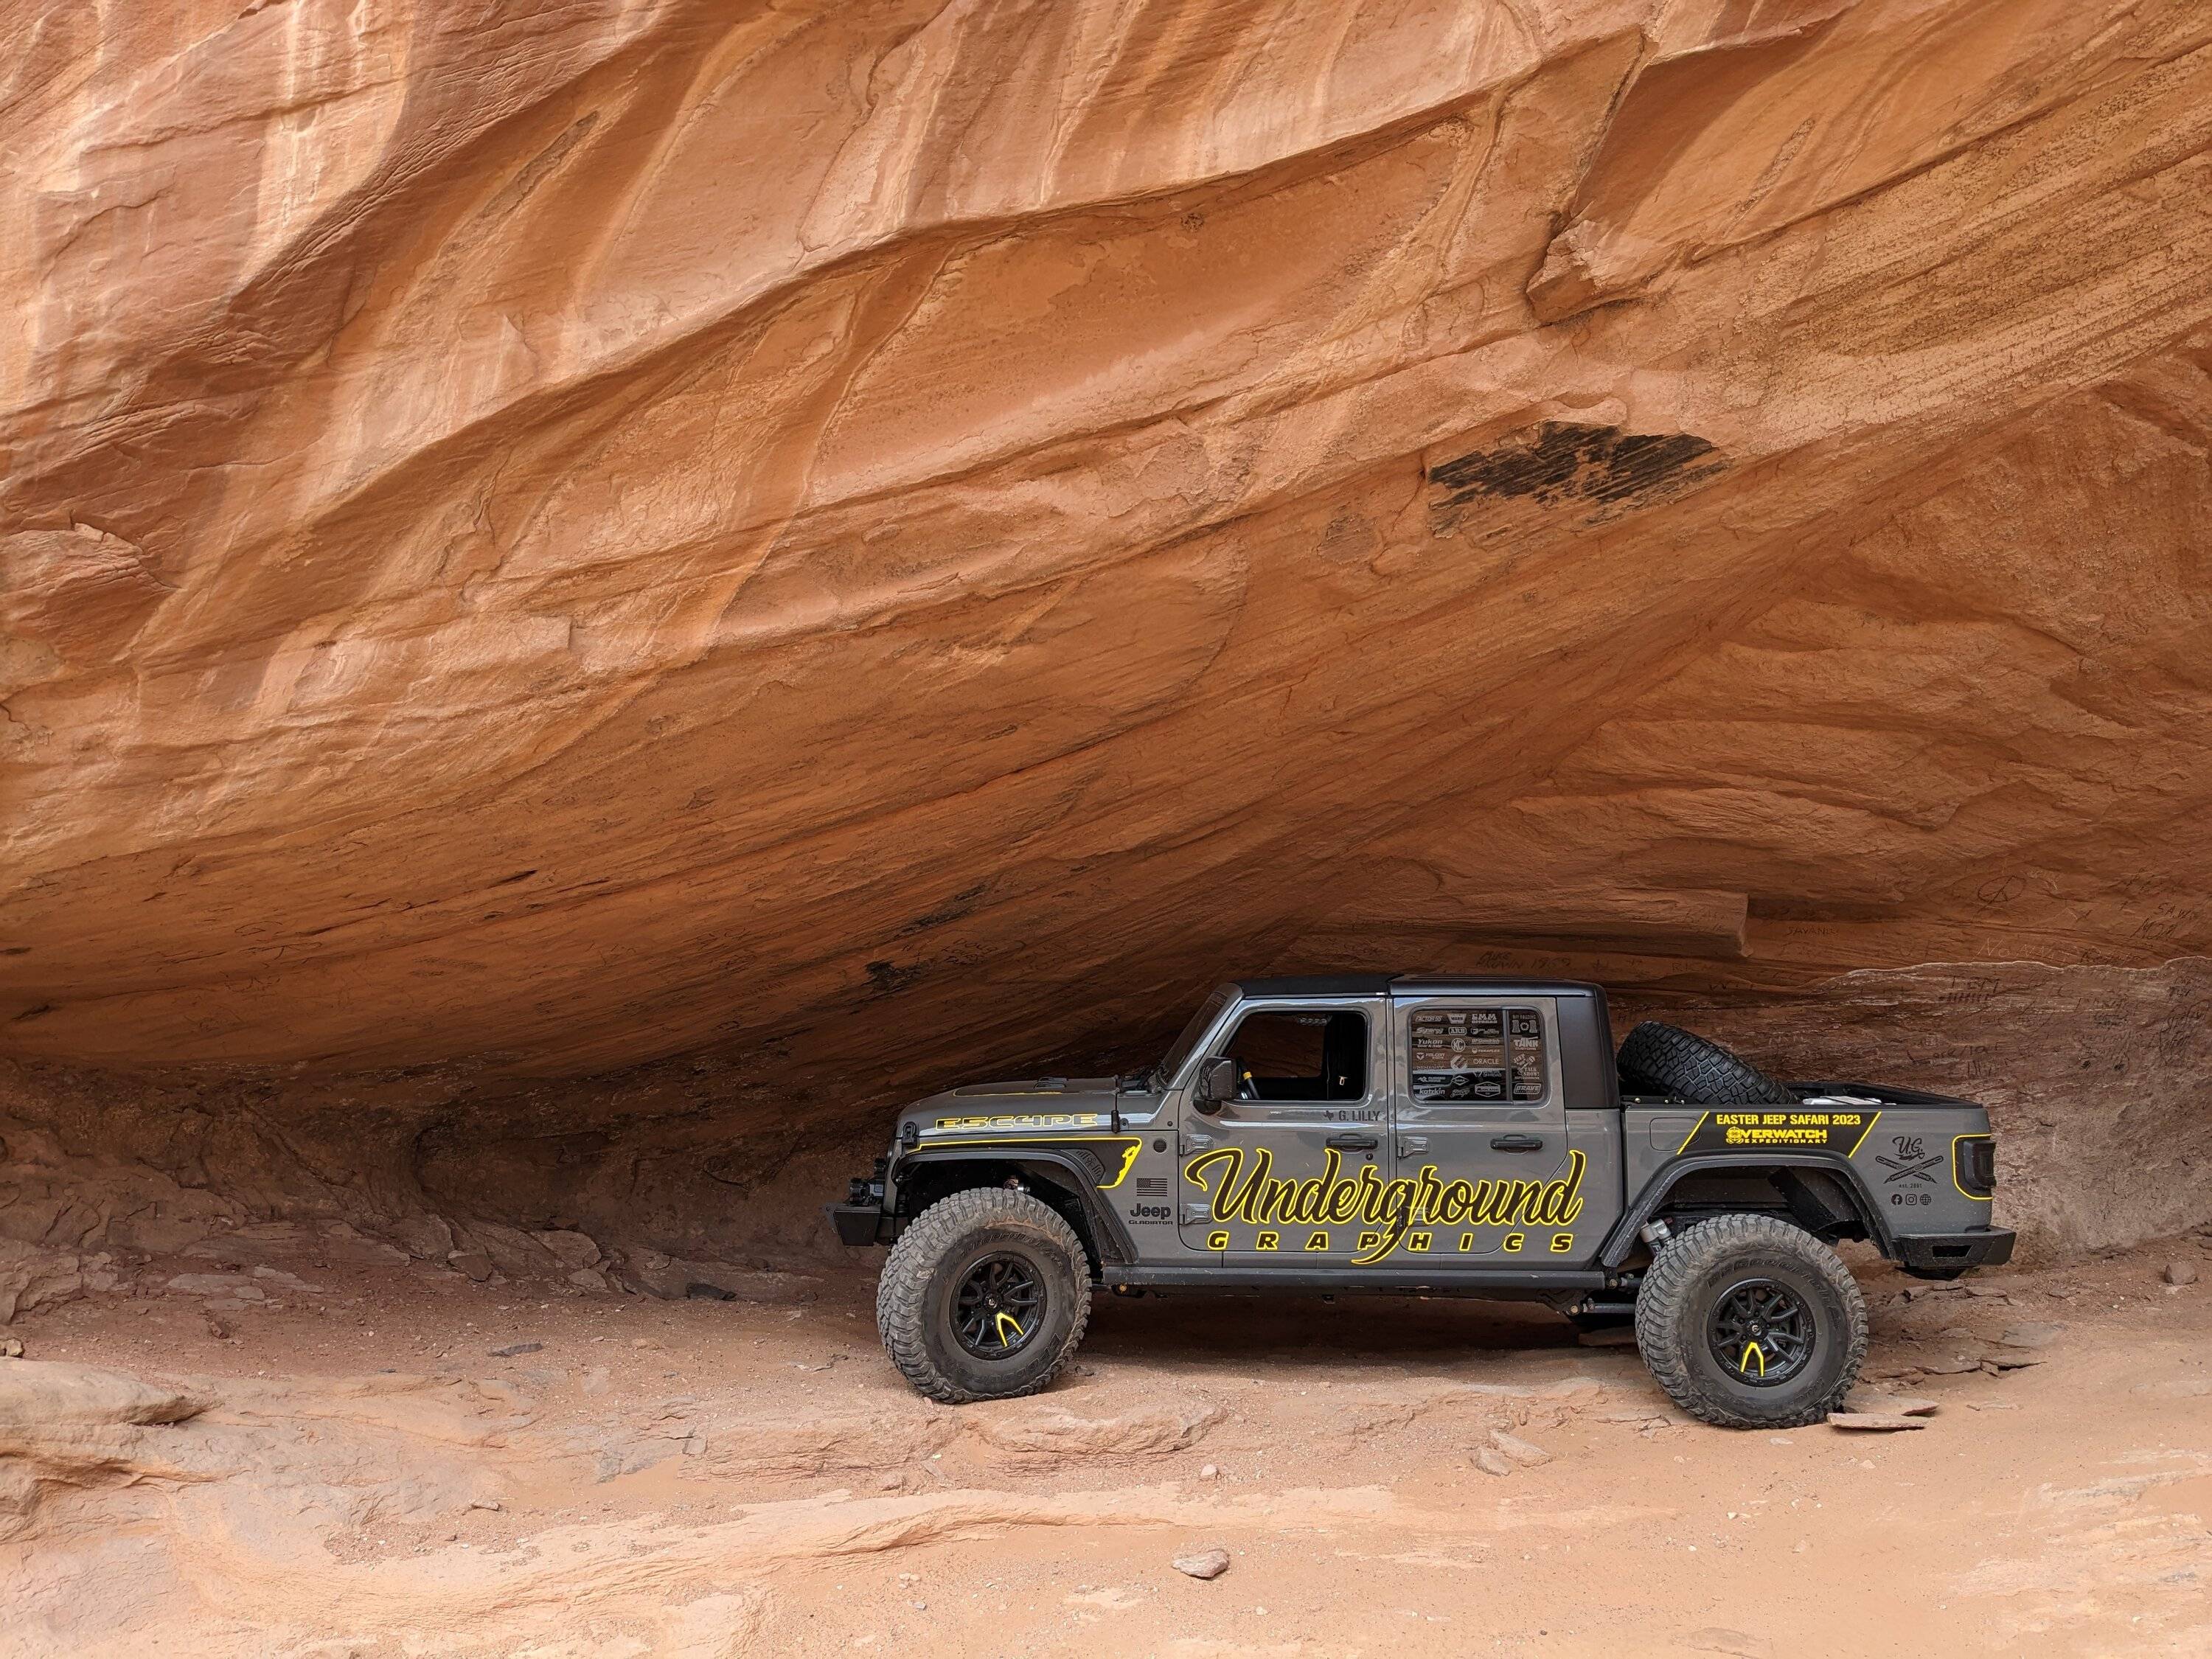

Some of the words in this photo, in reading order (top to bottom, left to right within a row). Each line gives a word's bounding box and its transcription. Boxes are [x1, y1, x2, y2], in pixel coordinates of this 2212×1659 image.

[1339, 1110, 1349, 1121] G.
[1352, 1110, 1380, 1121] LILLY
[1717, 1115, 1759, 1124] EASTER
[1762, 1115, 1786, 1124] JEEP
[1790, 1115, 1829, 1124] SAFARI
[1832, 1115, 1861, 1124] 2023
[1130, 1203, 1171, 1220] Jeep
[1185, 1148, 1586, 1264] Underground
[1207, 1231, 1574, 1253] GRAPHICS
